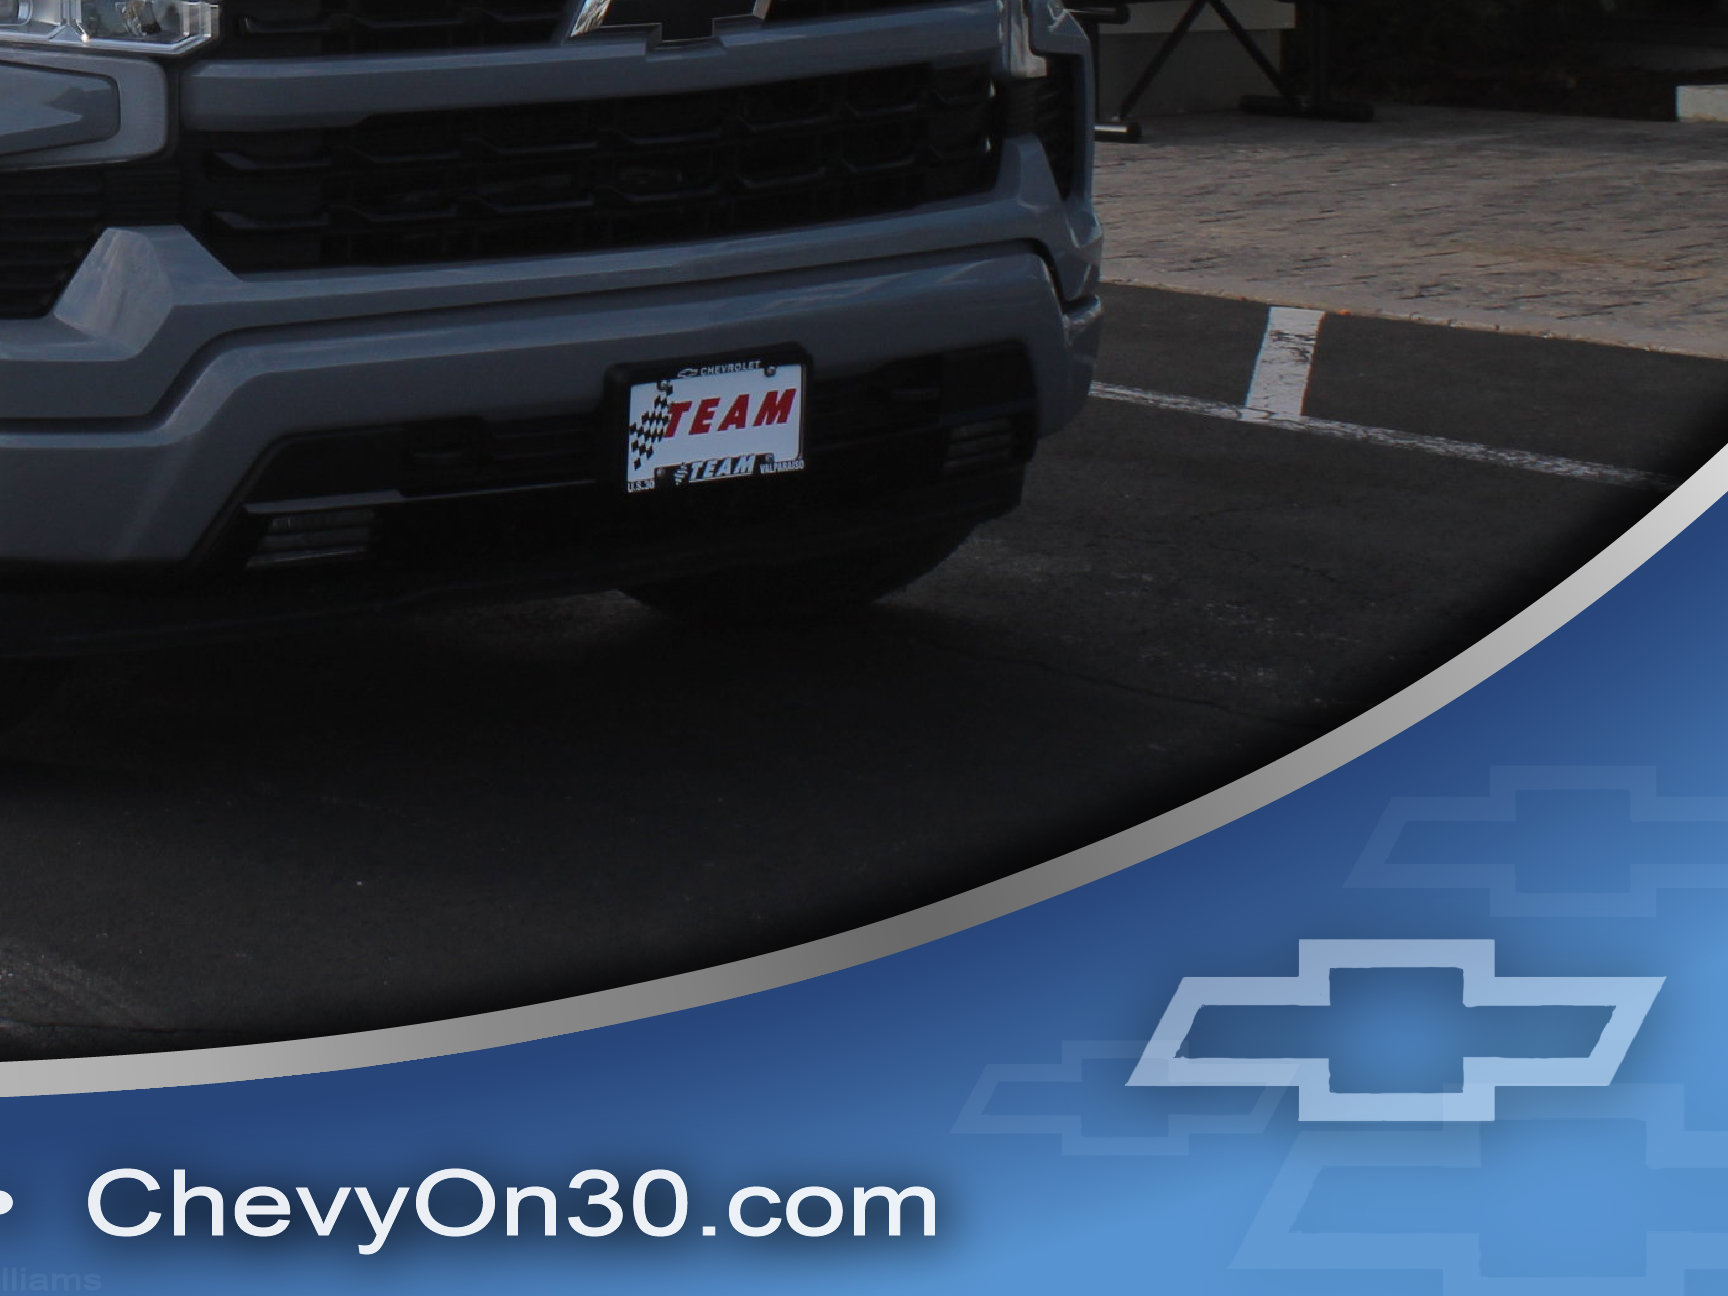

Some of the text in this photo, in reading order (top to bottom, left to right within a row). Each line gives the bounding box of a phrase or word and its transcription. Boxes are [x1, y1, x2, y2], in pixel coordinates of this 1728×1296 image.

[700, 360, 761, 376] CHEVROLET
[663, 388, 797, 438] TEAM
[689, 455, 756, 482] TEAM
